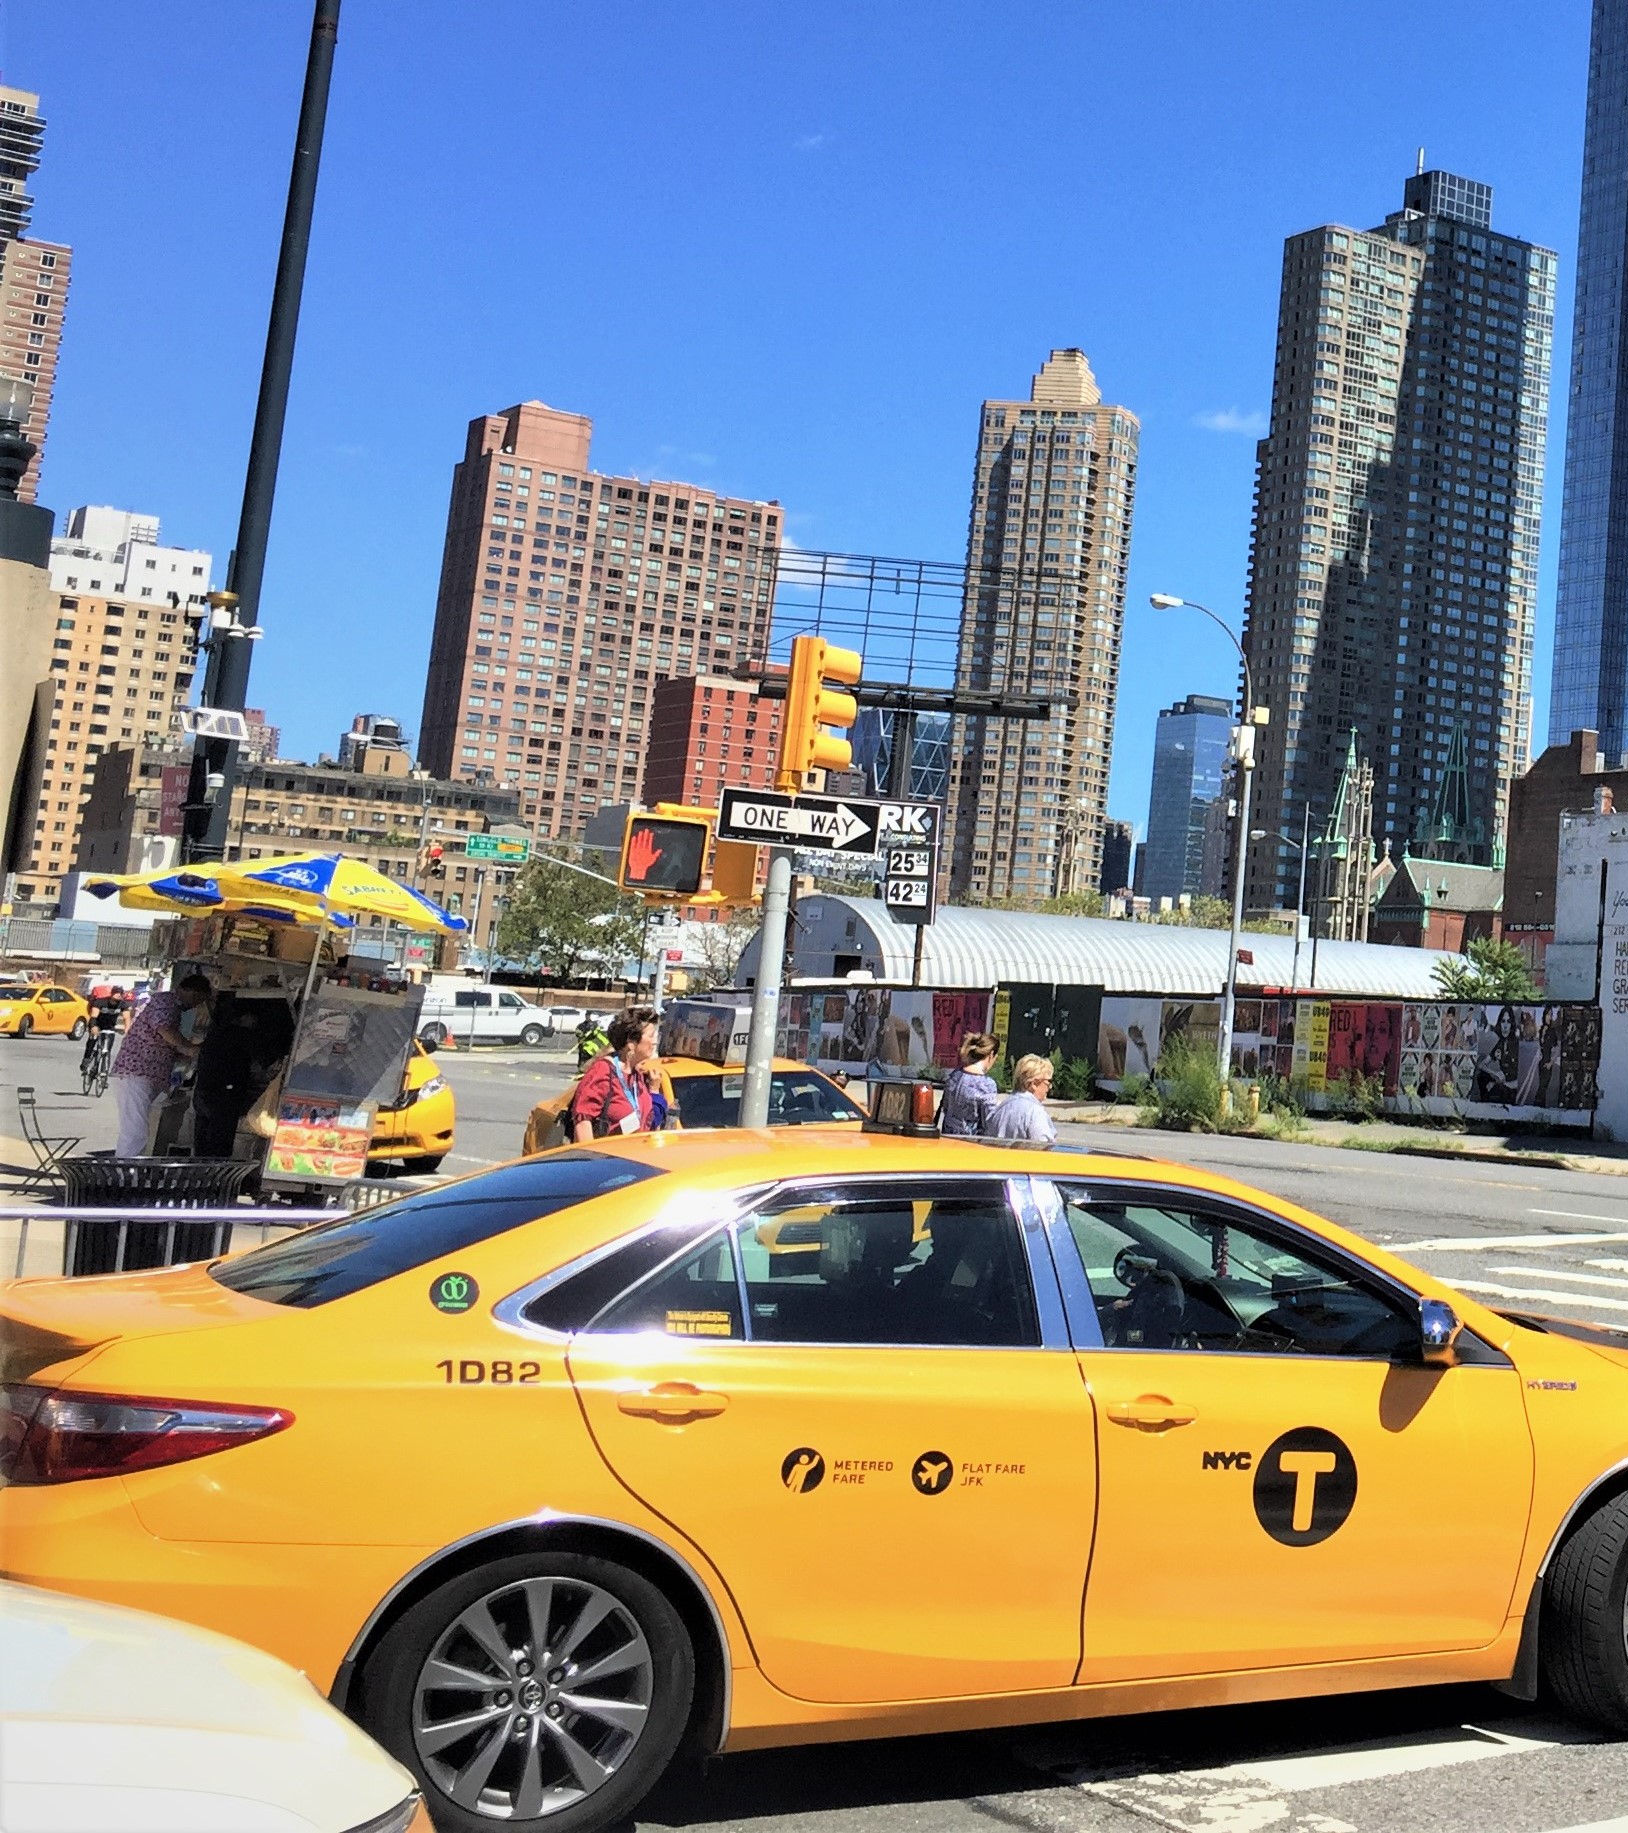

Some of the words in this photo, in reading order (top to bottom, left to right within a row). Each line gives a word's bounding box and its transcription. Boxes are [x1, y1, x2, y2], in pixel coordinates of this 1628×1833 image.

[743, 807, 789, 830] ONE
[811, 814, 856, 836] WAY
[891, 852, 915, 873] 25
[916, 853, 928, 864] 34
[889, 882, 914, 902] 42
[914, 884, 926, 894] 24
[436, 1359, 541, 1384] 1D82
[834, 1460, 893, 1472] METERED
[961, 1462, 991, 1474] FLAT
[995, 1463, 1026, 1475] FARE
[833, 1473, 865, 1485] FARE
[960, 1476, 984, 1487] JFK
[1202, 1451, 1252, 1470] NYC
[1279, 1451, 1336, 1531] T
